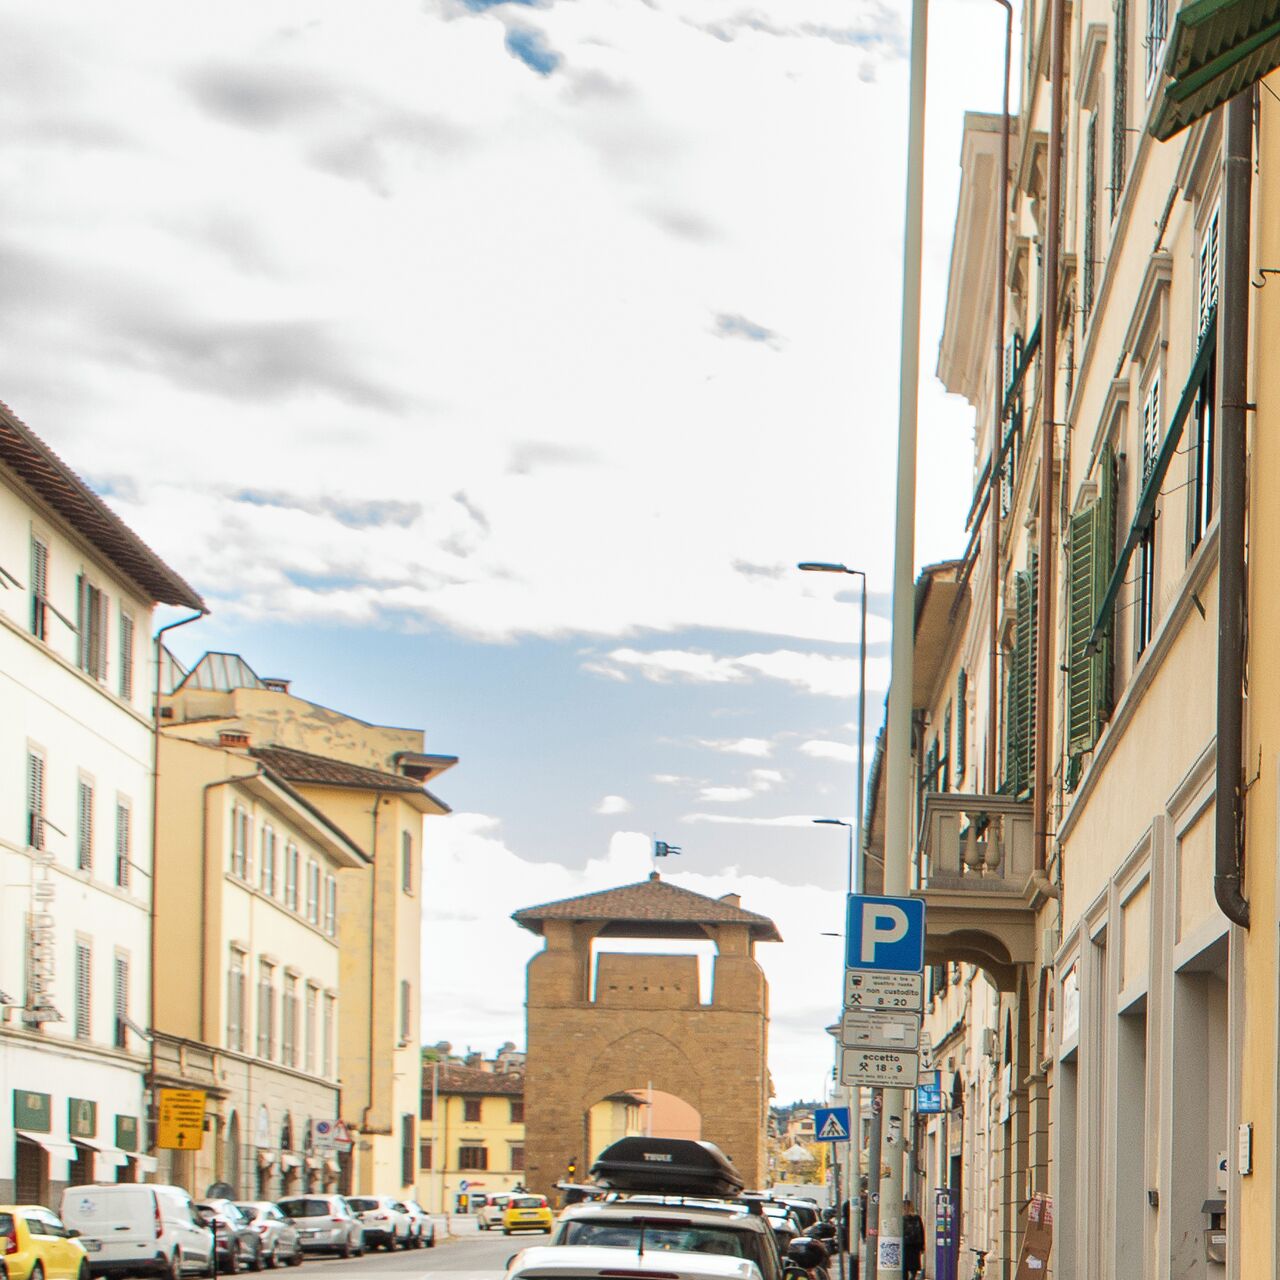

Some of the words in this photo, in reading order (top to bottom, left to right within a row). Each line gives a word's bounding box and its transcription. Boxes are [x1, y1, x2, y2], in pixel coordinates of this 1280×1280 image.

[860, 902, 909, 963] P
[884, 988, 919, 996] custodito
[894, 998, 907, 1007] 20
[863, 1054, 900, 1062] eccetto
[876, 1064, 887, 1072] 18
[896, 1065, 903, 1073] 9
